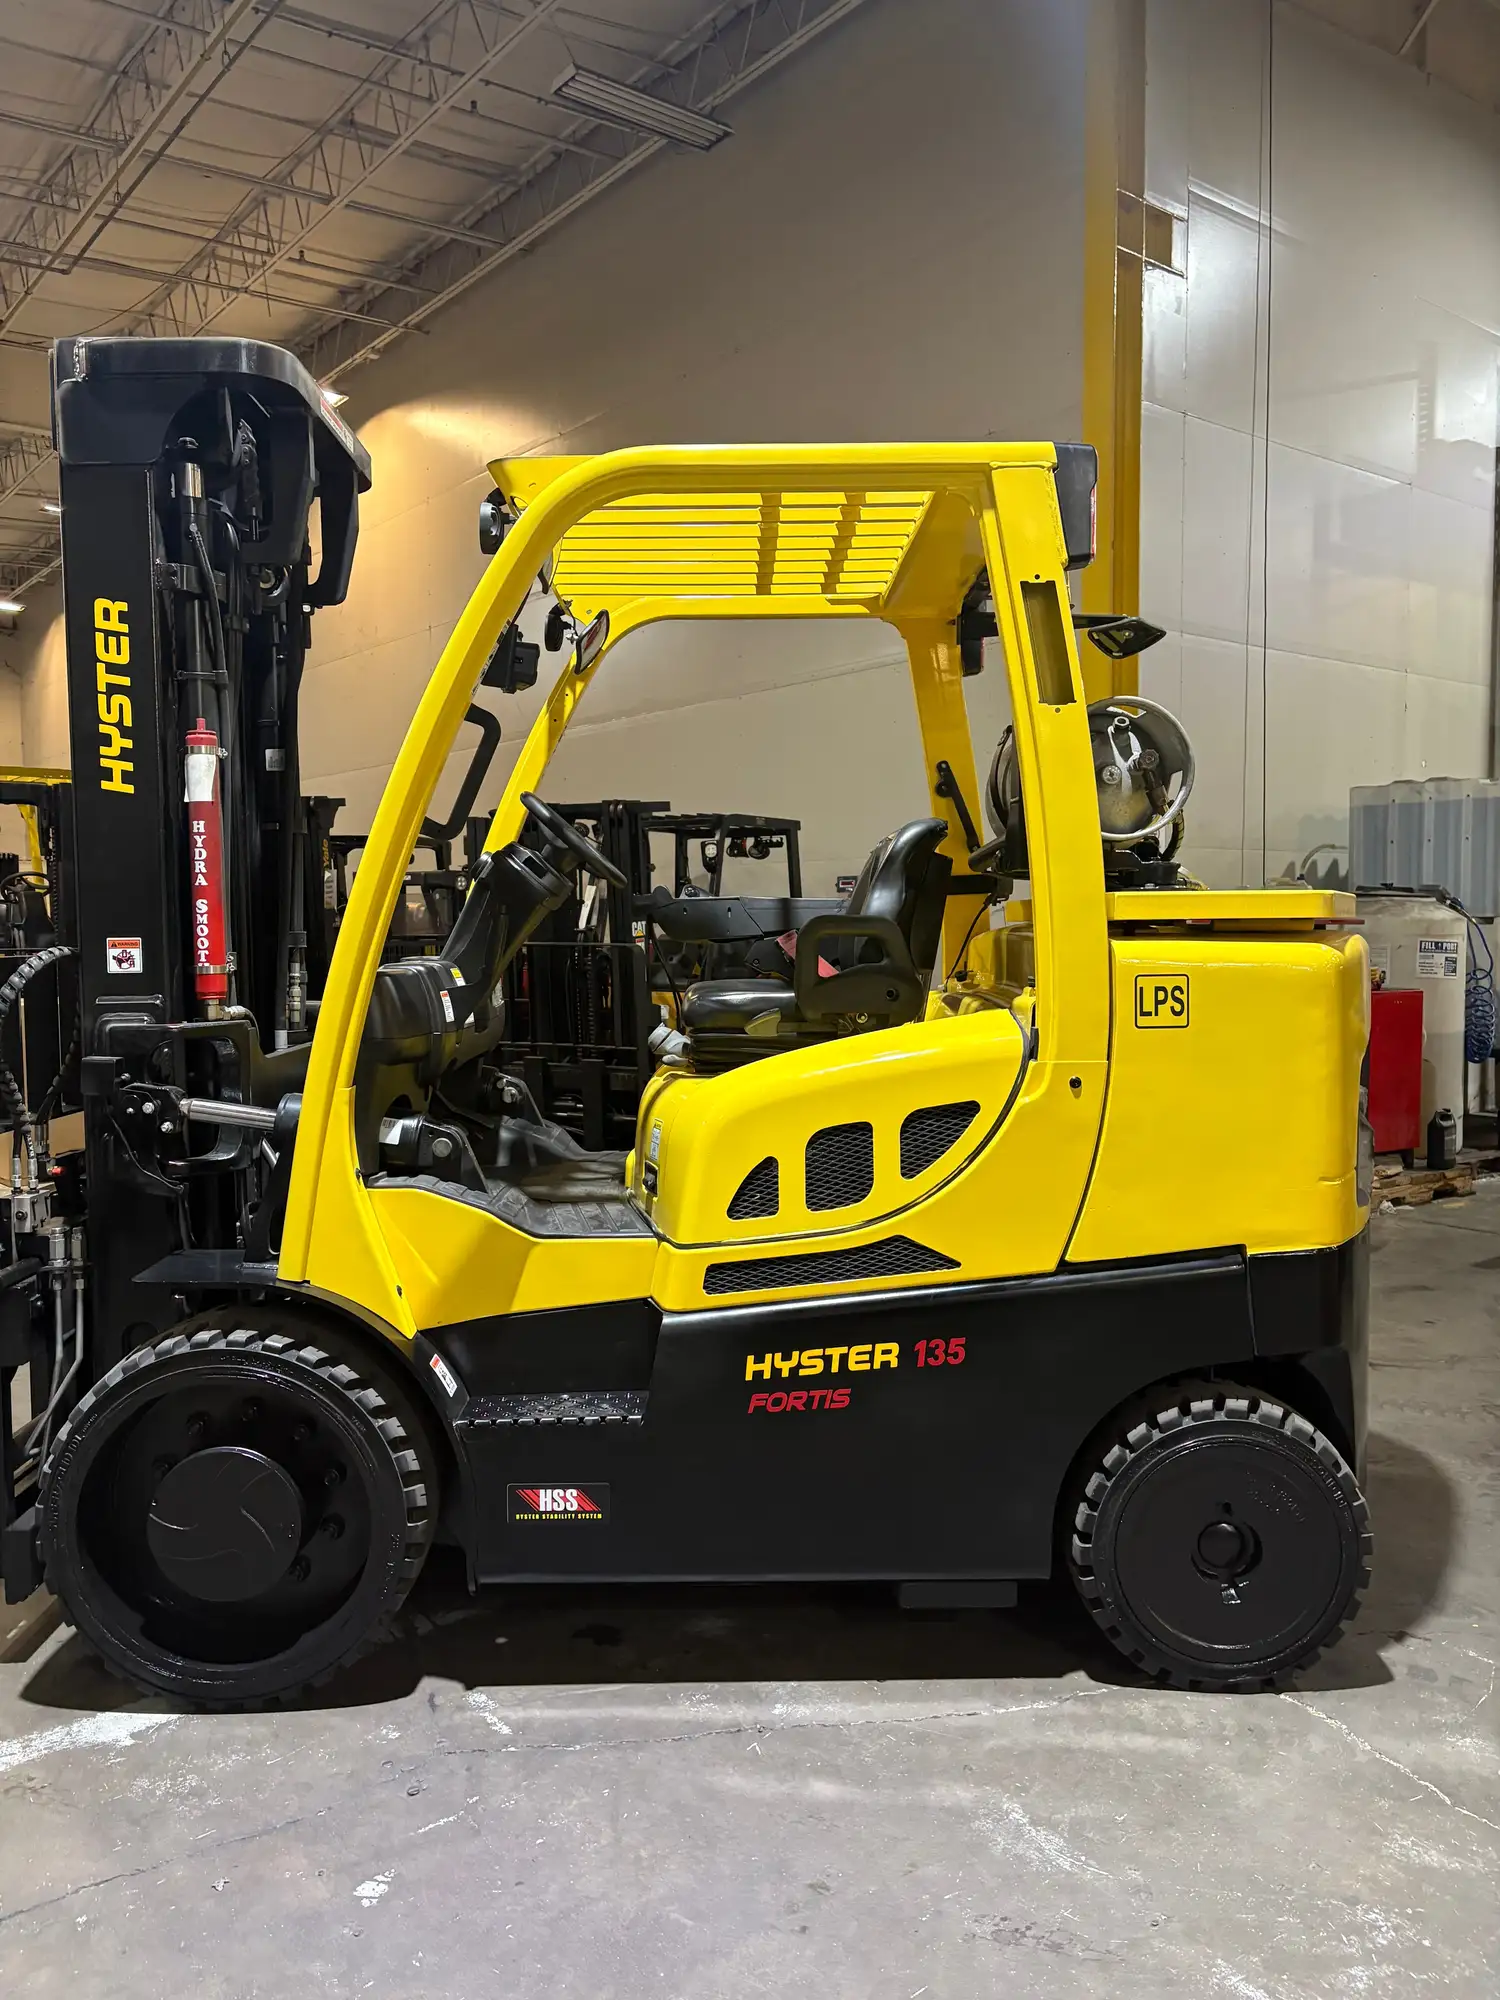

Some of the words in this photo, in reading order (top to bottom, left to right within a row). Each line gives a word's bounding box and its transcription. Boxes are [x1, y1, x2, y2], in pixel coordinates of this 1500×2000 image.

[94, 598, 135, 795] HYSTER
[193, 820, 209, 886] HYDRA
[195, 899, 212, 967] SMOOT
[631, 920, 647, 937] CAT
[1421, 941, 1436, 950] FILL
[1442, 941, 1458, 950] PORT
[1139, 985, 1184, 1017] LPS
[745, 1342, 900, 1382] HYSTER
[914, 1337, 967, 1368] 135
[747, 1388, 851, 1414] FORTIS
[539, 1488, 579, 1512] HSS
